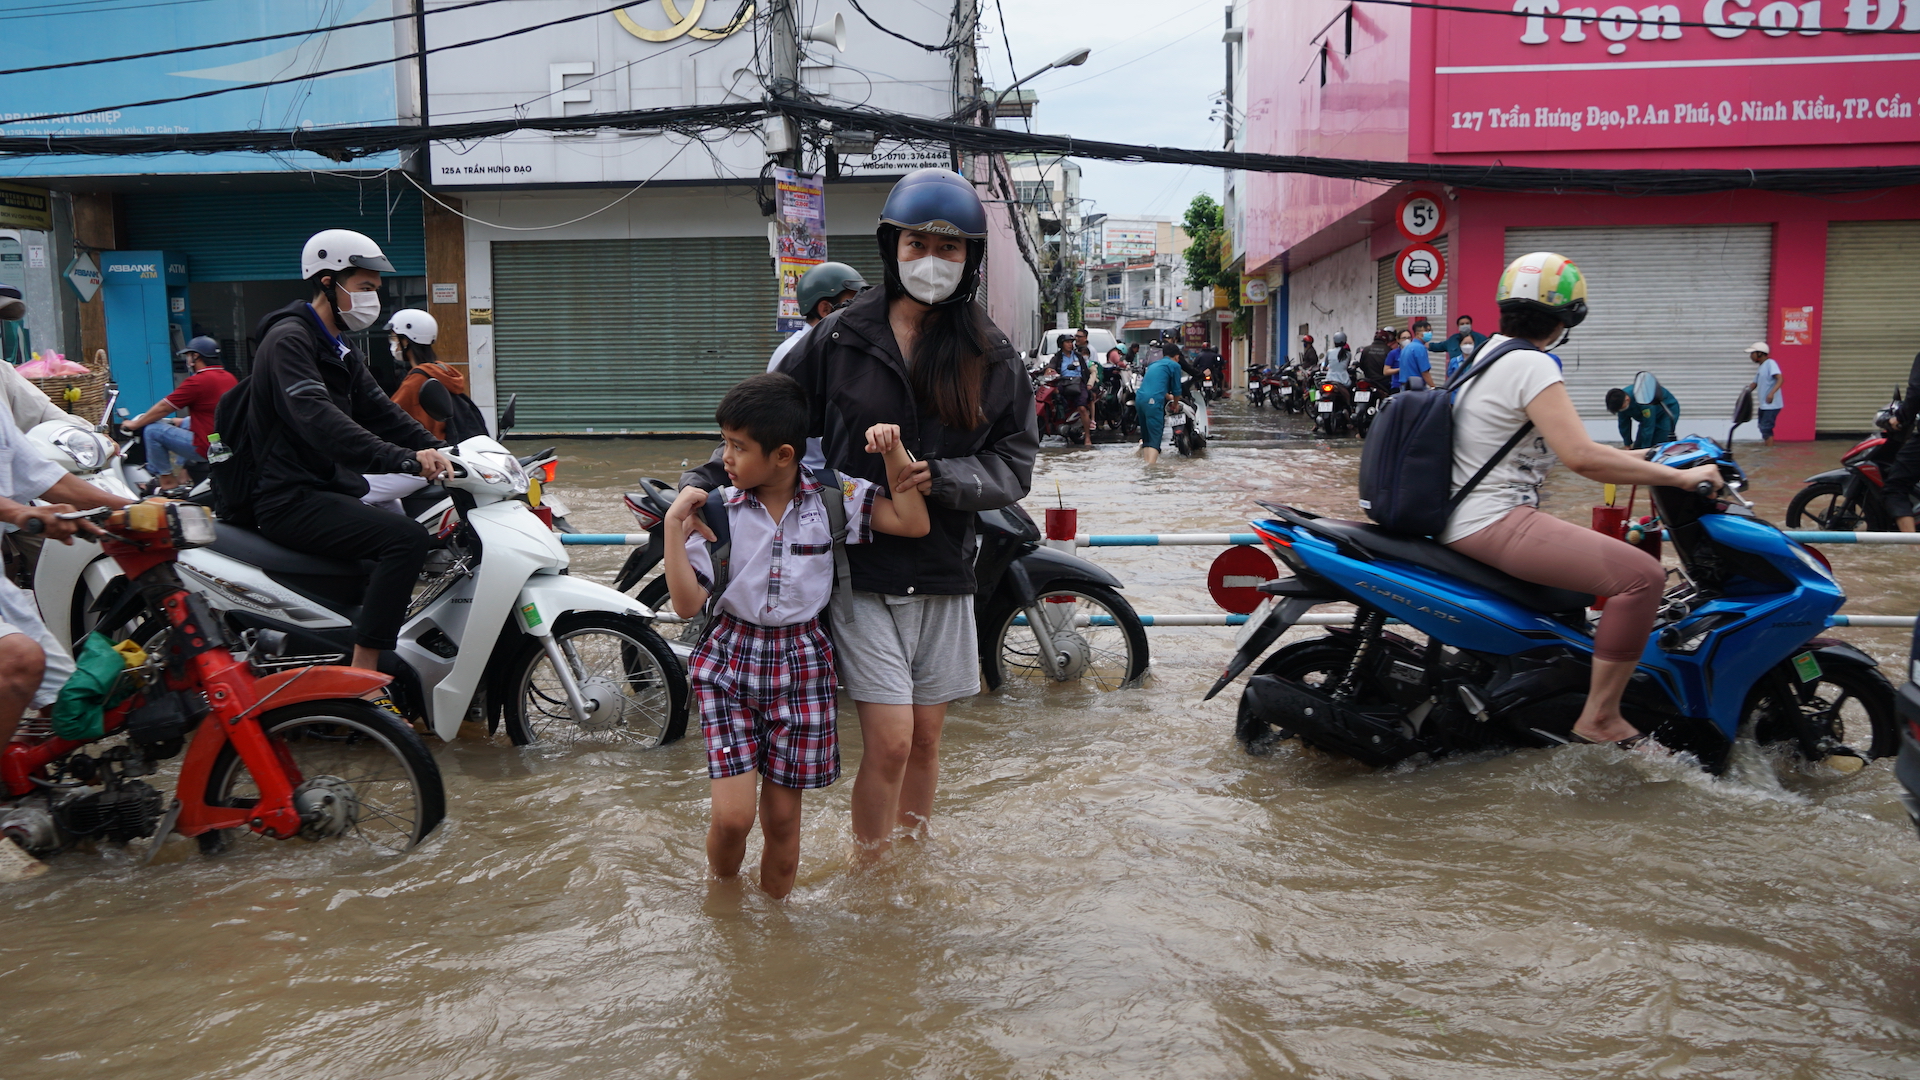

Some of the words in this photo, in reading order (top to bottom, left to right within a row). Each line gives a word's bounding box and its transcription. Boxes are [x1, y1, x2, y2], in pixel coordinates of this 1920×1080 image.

[1513, 0, 1682, 55] Trọn
[1451, 111, 1483, 131] 127
[1488, 104, 1530, 127] Trần
[1534, 107, 1582, 131] Hưng
[918, 221, 960, 236] Andes
[139, 271, 158, 279] ATM
[168, 264, 186, 274] ATM
